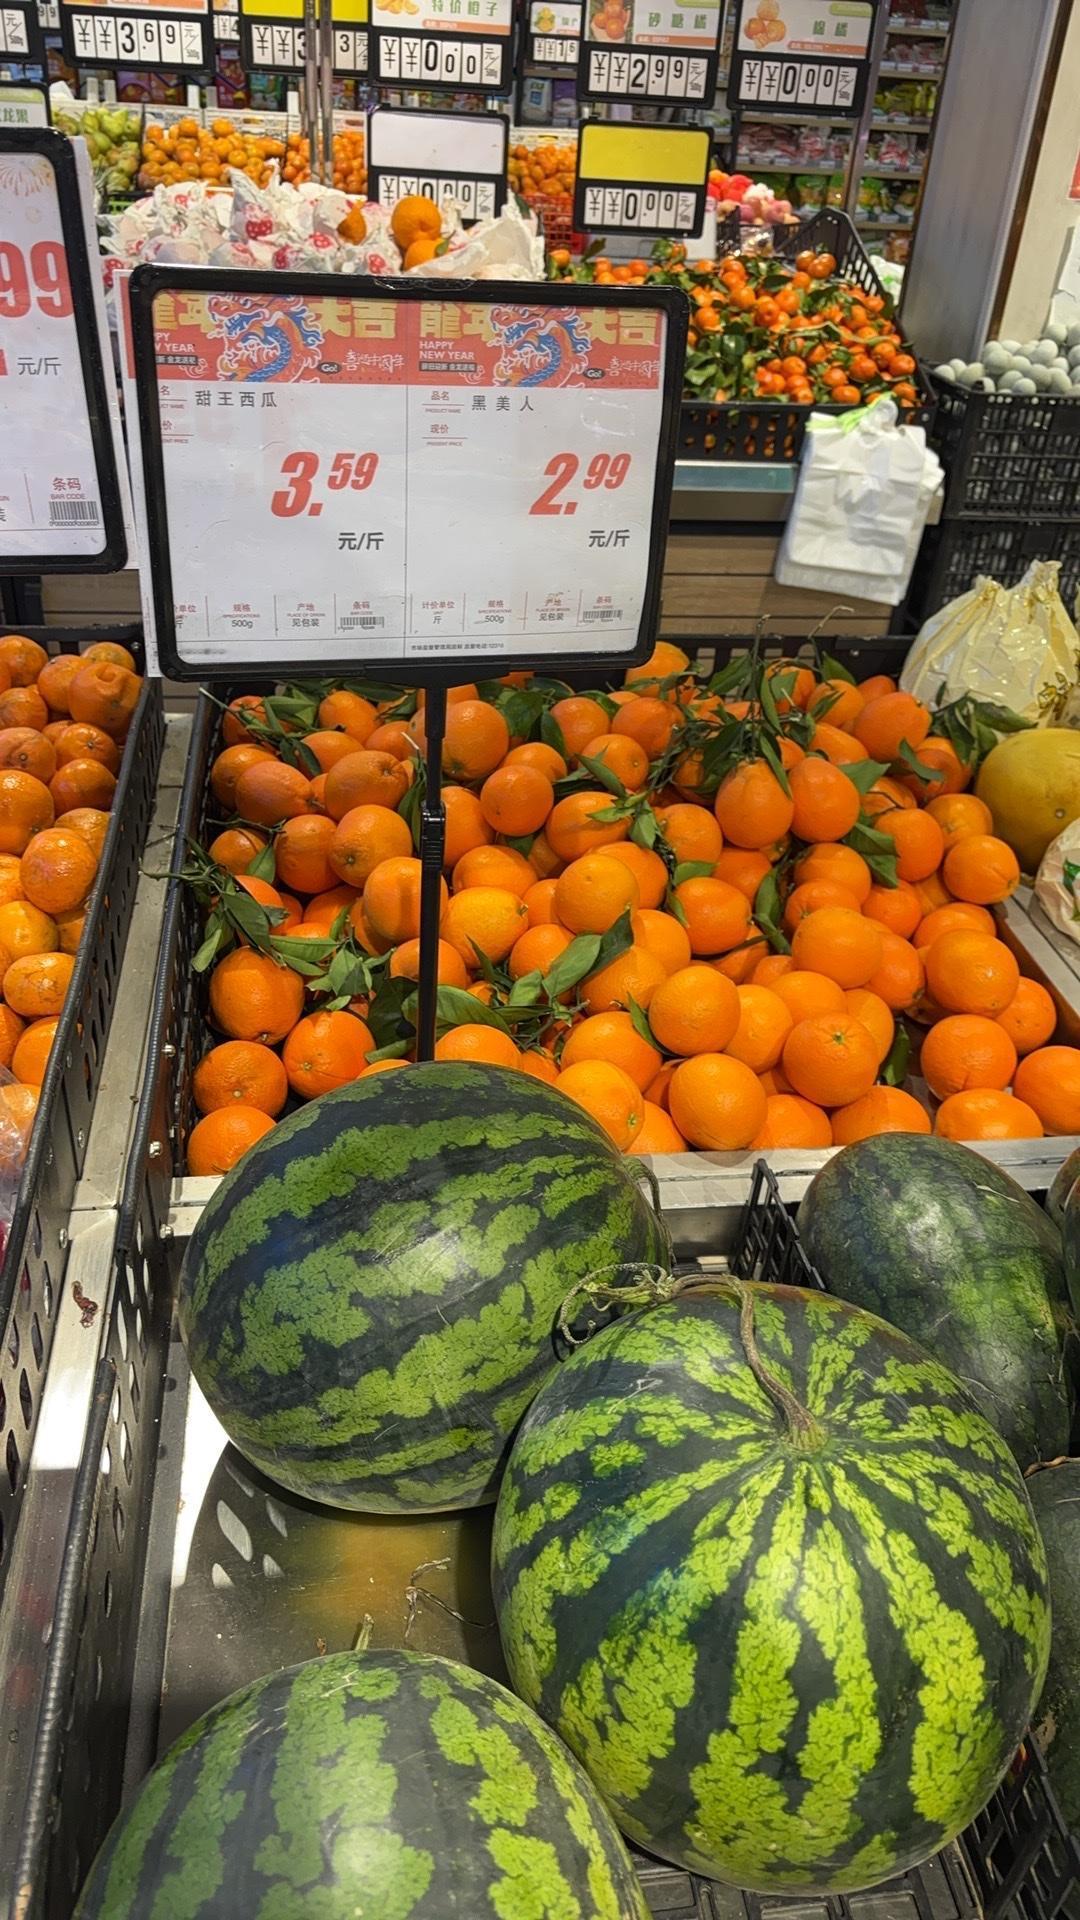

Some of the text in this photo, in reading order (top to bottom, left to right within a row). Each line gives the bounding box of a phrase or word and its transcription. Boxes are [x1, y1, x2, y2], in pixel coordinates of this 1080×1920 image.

[164, 342, 195, 352] YEAR
[419, 340, 455, 350] HAPPY
[419, 350, 476, 361] NEW YEAR
[17, 357, 62, 376] 元/斤
[195, 390, 278, 408] 甜王西瓜
[471, 395, 534, 411] 黑美人
[53, 477, 82, 491] 条码
[271, 451, 380, 518] 3.59
[528, 452, 632, 516] 2.99
[338, 531, 385, 550] 元/斤
[588, 529, 631, 548] 元/斤
[231, 619, 254, 629] 500g
[484, 614, 505, 624] 500g
